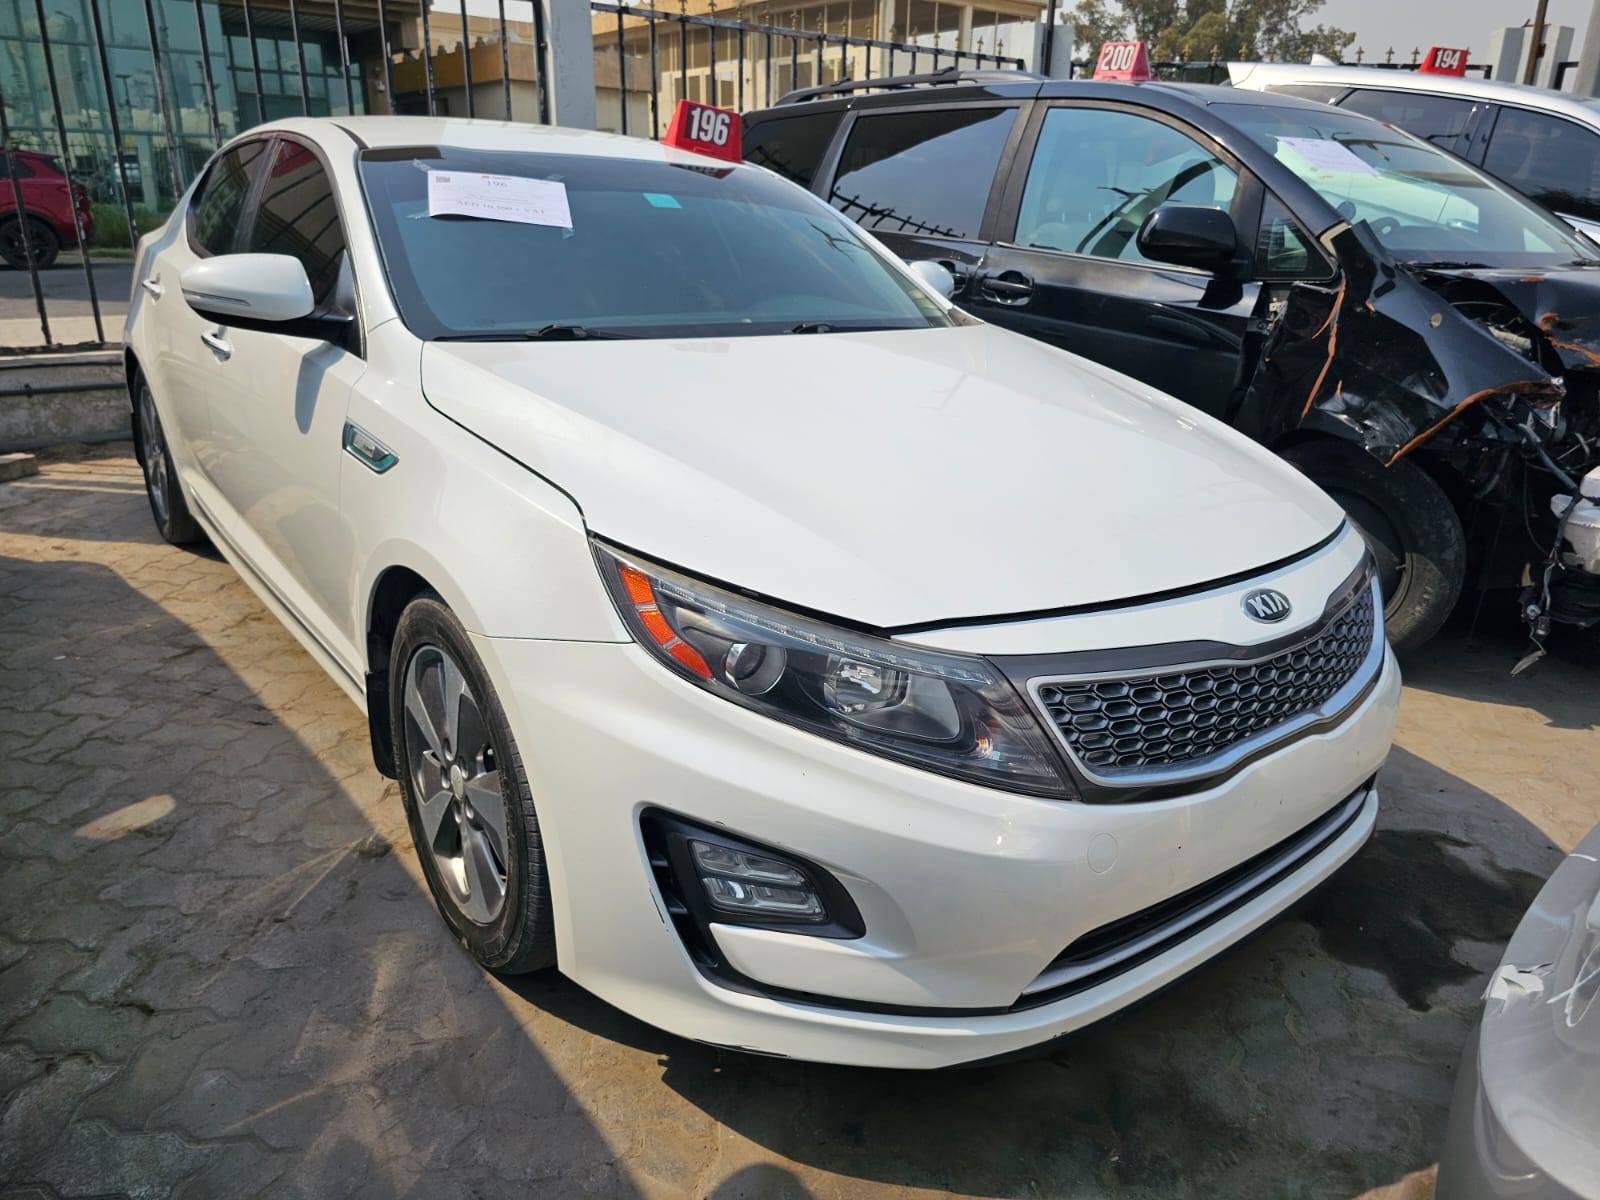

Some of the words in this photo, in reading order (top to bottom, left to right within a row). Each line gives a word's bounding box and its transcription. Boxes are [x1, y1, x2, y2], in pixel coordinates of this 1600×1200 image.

[1101, 45, 1135, 71] 200
[1434, 49, 1461, 70] 194
[690, 107, 731, 146] 196
[1247, 592, 1289, 617] KIA
